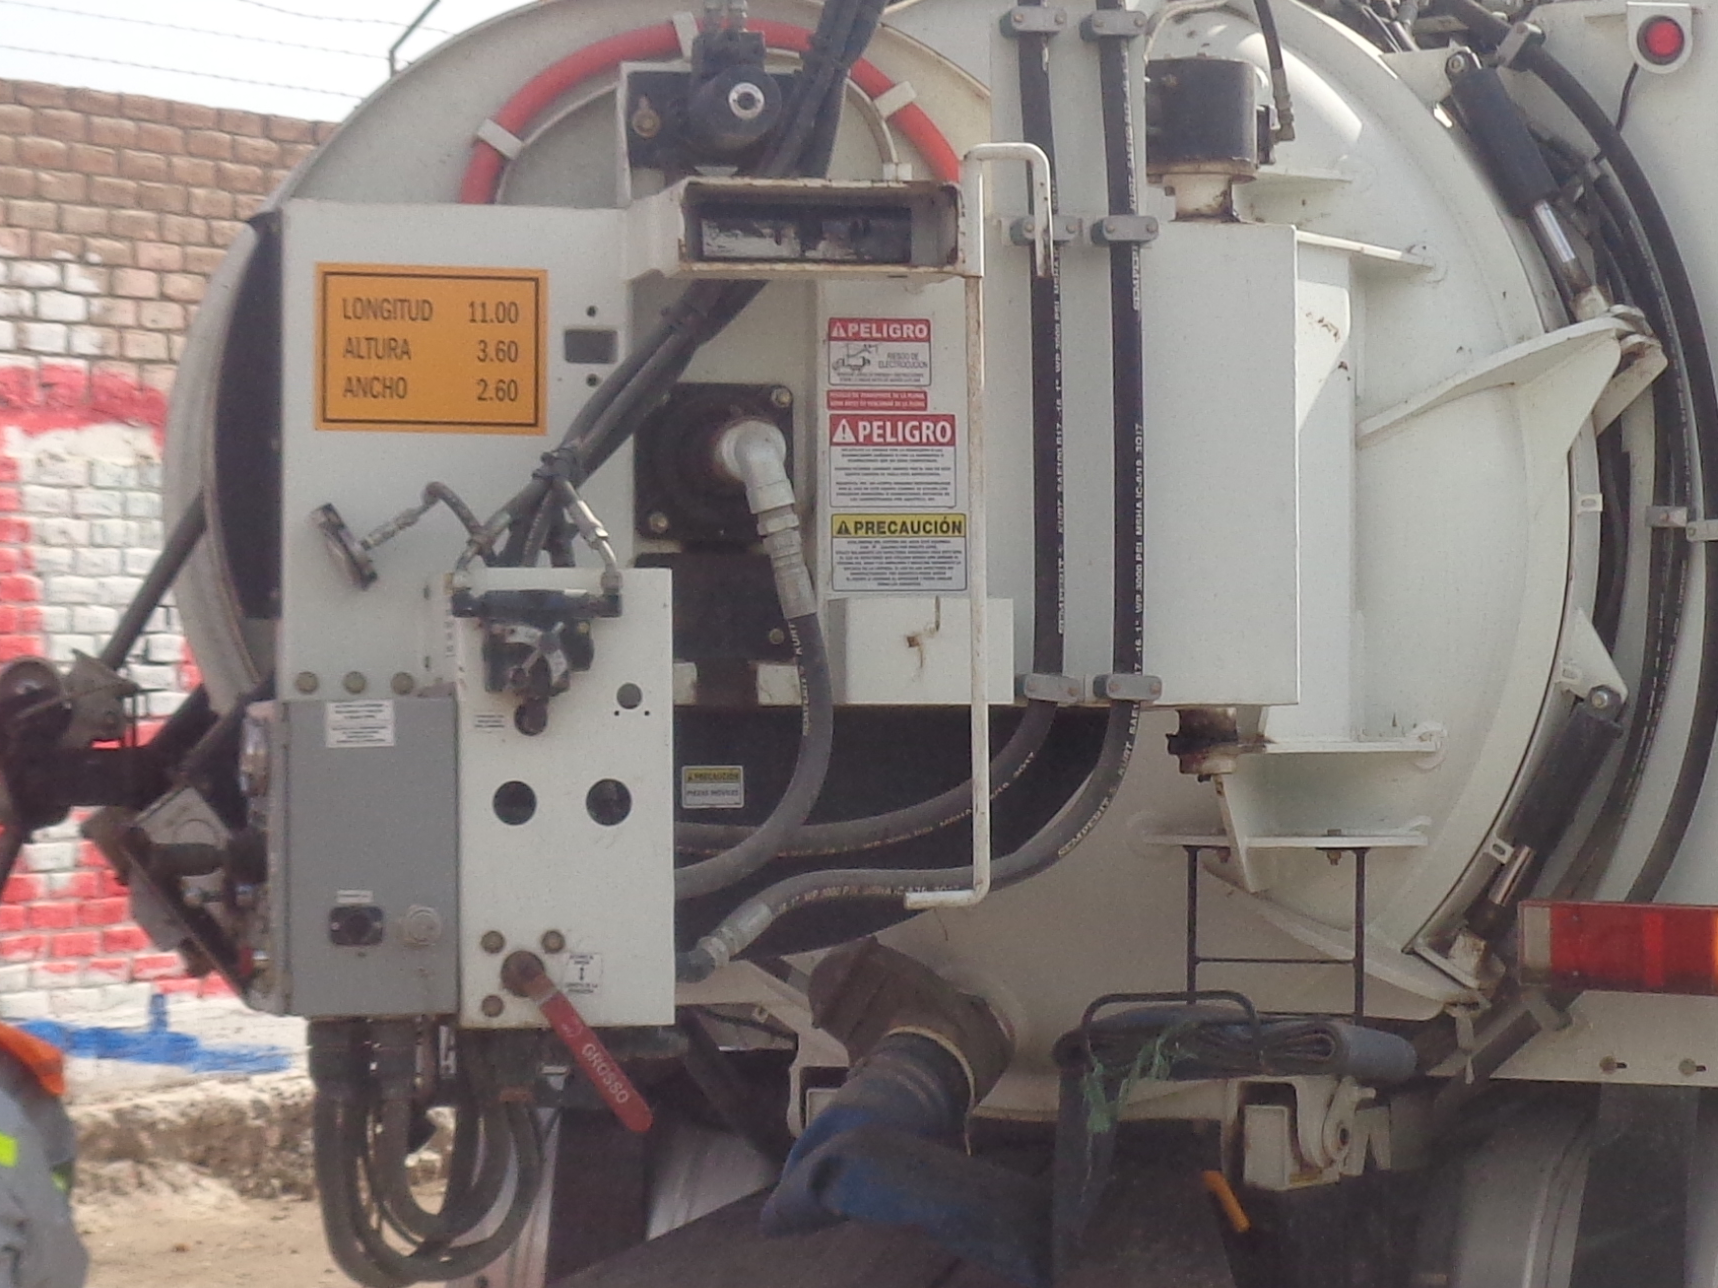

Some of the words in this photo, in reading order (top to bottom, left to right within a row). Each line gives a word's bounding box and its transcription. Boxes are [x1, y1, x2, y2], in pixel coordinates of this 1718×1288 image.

[342, 297, 433, 322] LONGITUD
[469, 300, 519, 324] 11.00
[847, 323, 928, 338] PELIGRO
[343, 336, 412, 360] ALTURA
[477, 339, 519, 363] 3.60
[343, 375, 408, 399] ANCHO
[476, 378, 519, 402] 2.60
[857, 420, 952, 443] PELIGRO
[854, 515, 962, 535] PRECAUCIÓN
[1135, 501, 1143, 536] MSHA
